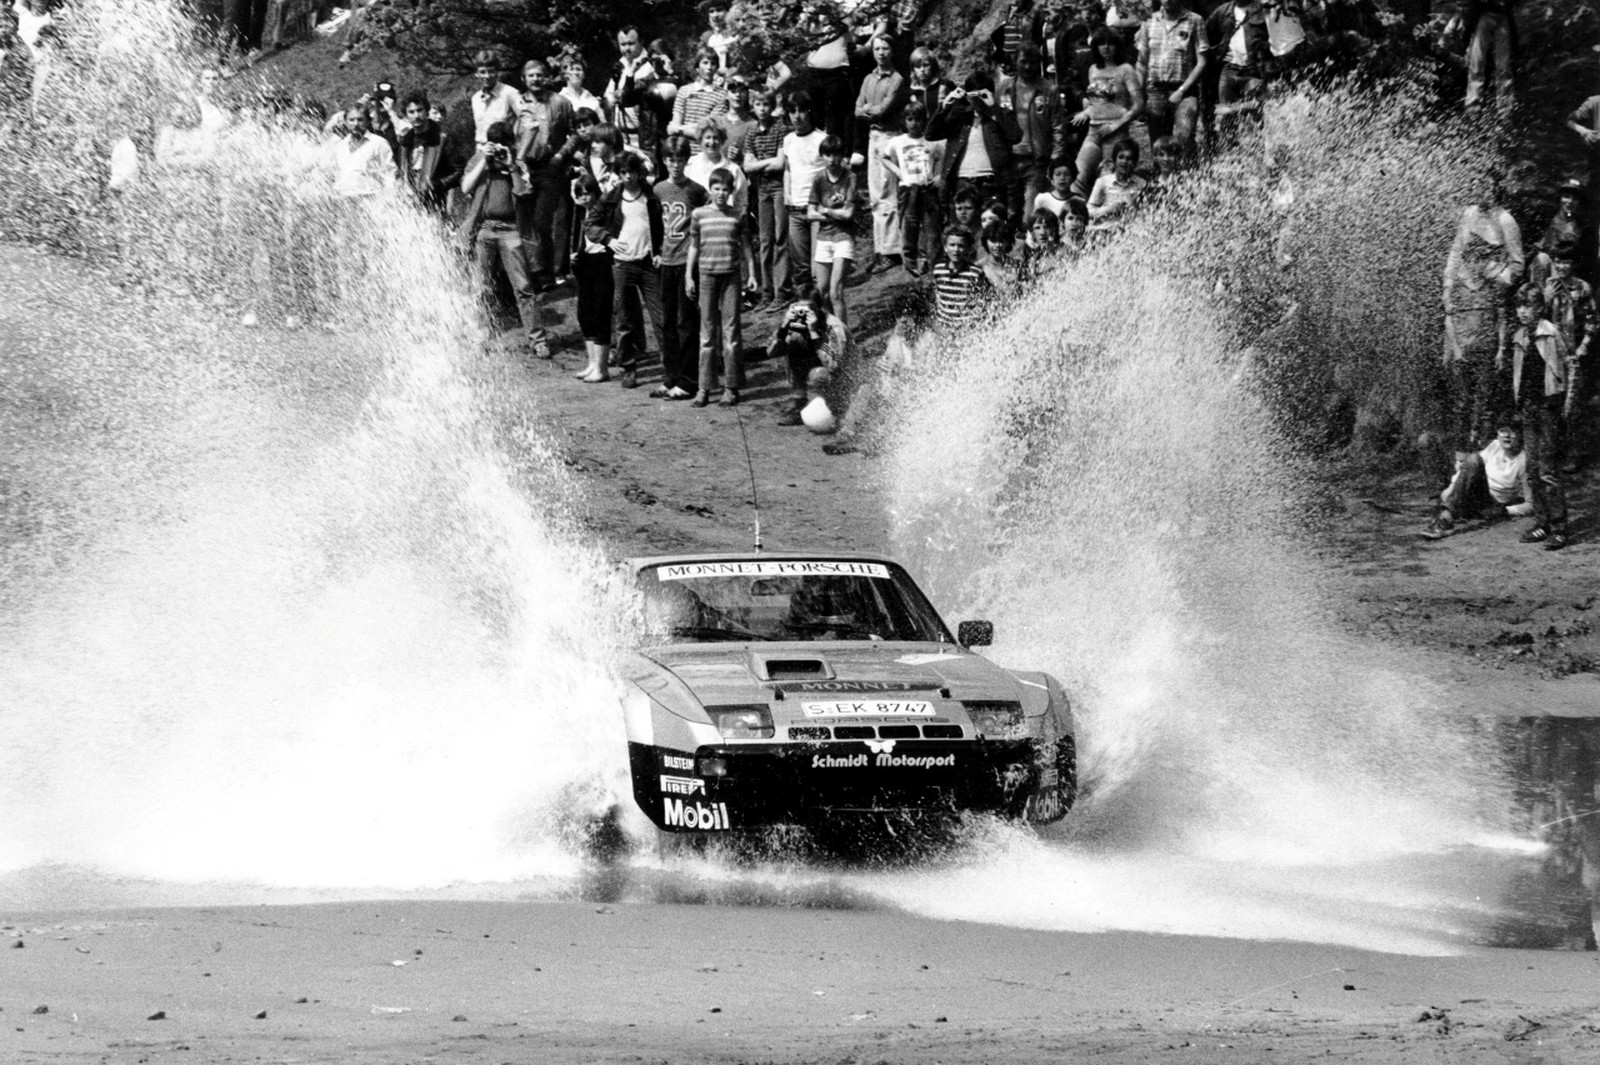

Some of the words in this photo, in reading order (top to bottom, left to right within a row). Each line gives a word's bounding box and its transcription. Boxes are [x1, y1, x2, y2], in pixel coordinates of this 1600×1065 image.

[801, 682, 911, 691] MONNET
[876, 703, 927, 713] 8747
[811, 754, 868, 768] Schmidt
[876, 753, 955, 769] Motorsport
[663, 797, 729, 830] Mobil
